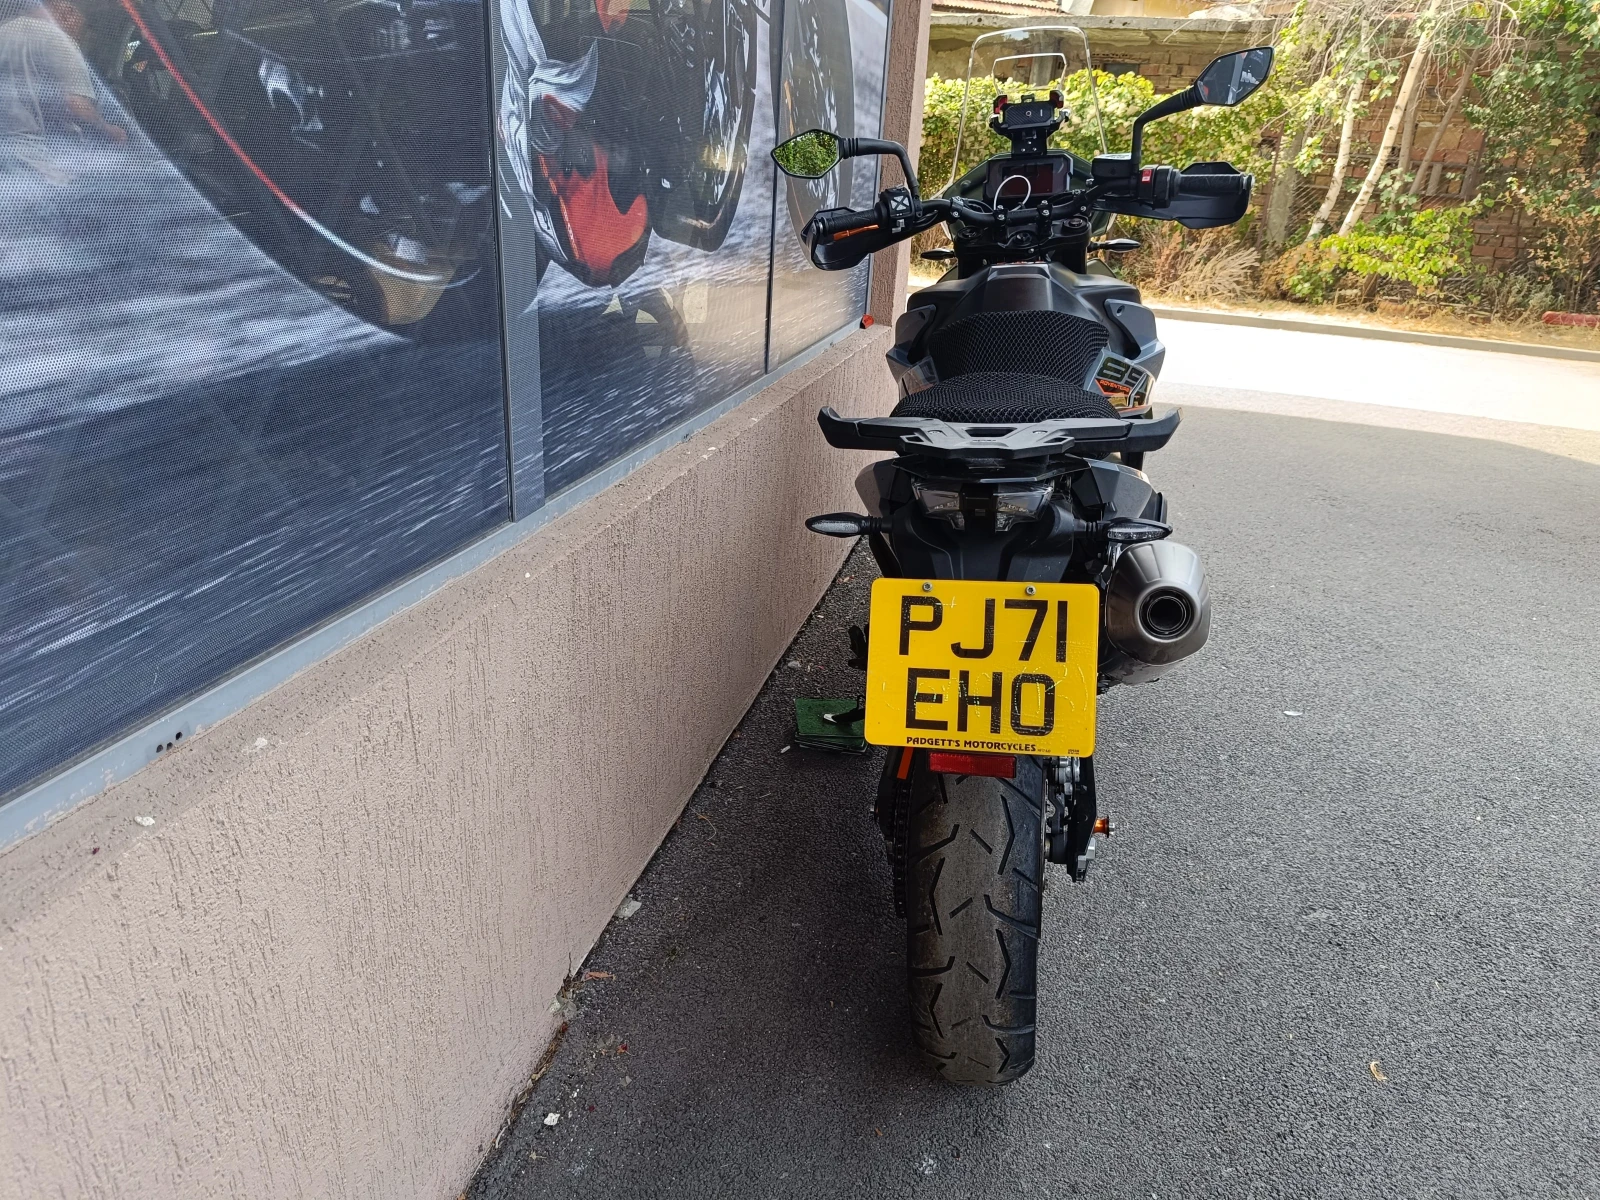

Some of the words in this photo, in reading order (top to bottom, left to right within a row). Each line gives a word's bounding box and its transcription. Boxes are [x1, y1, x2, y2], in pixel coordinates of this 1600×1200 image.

[898, 595, 1068, 663] PJ71
[905, 667, 1056, 737] EHO
[906, 736, 961, 748] PADGETT'S
[963, 740, 1037, 752] MOTORCYCLES
